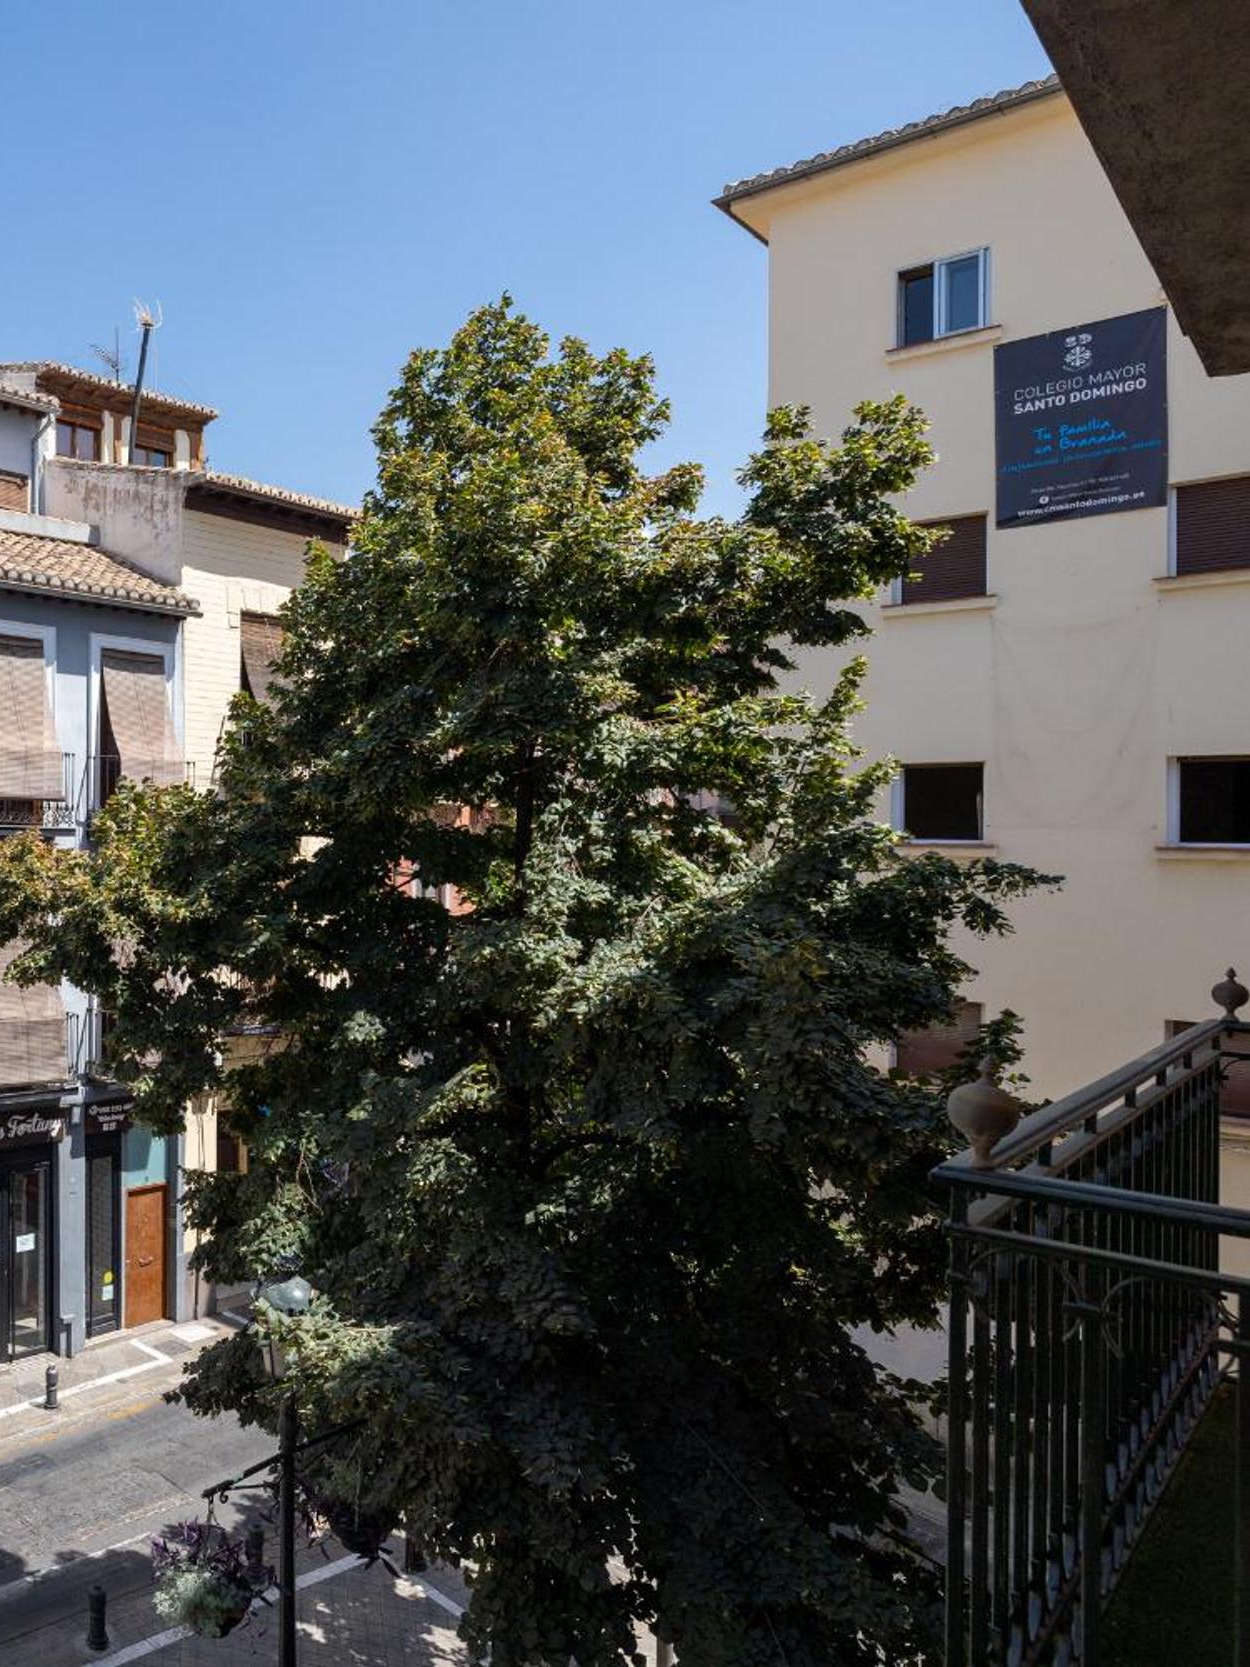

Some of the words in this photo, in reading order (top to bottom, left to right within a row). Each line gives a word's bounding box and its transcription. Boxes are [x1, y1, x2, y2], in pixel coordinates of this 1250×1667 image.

[1014, 376, 1083, 401] COLEGIO
[1089, 363, 1146, 385] MAYOR
[1014, 394, 1066, 415] SANTO
[1069, 378, 1147, 403] DOMINGO
